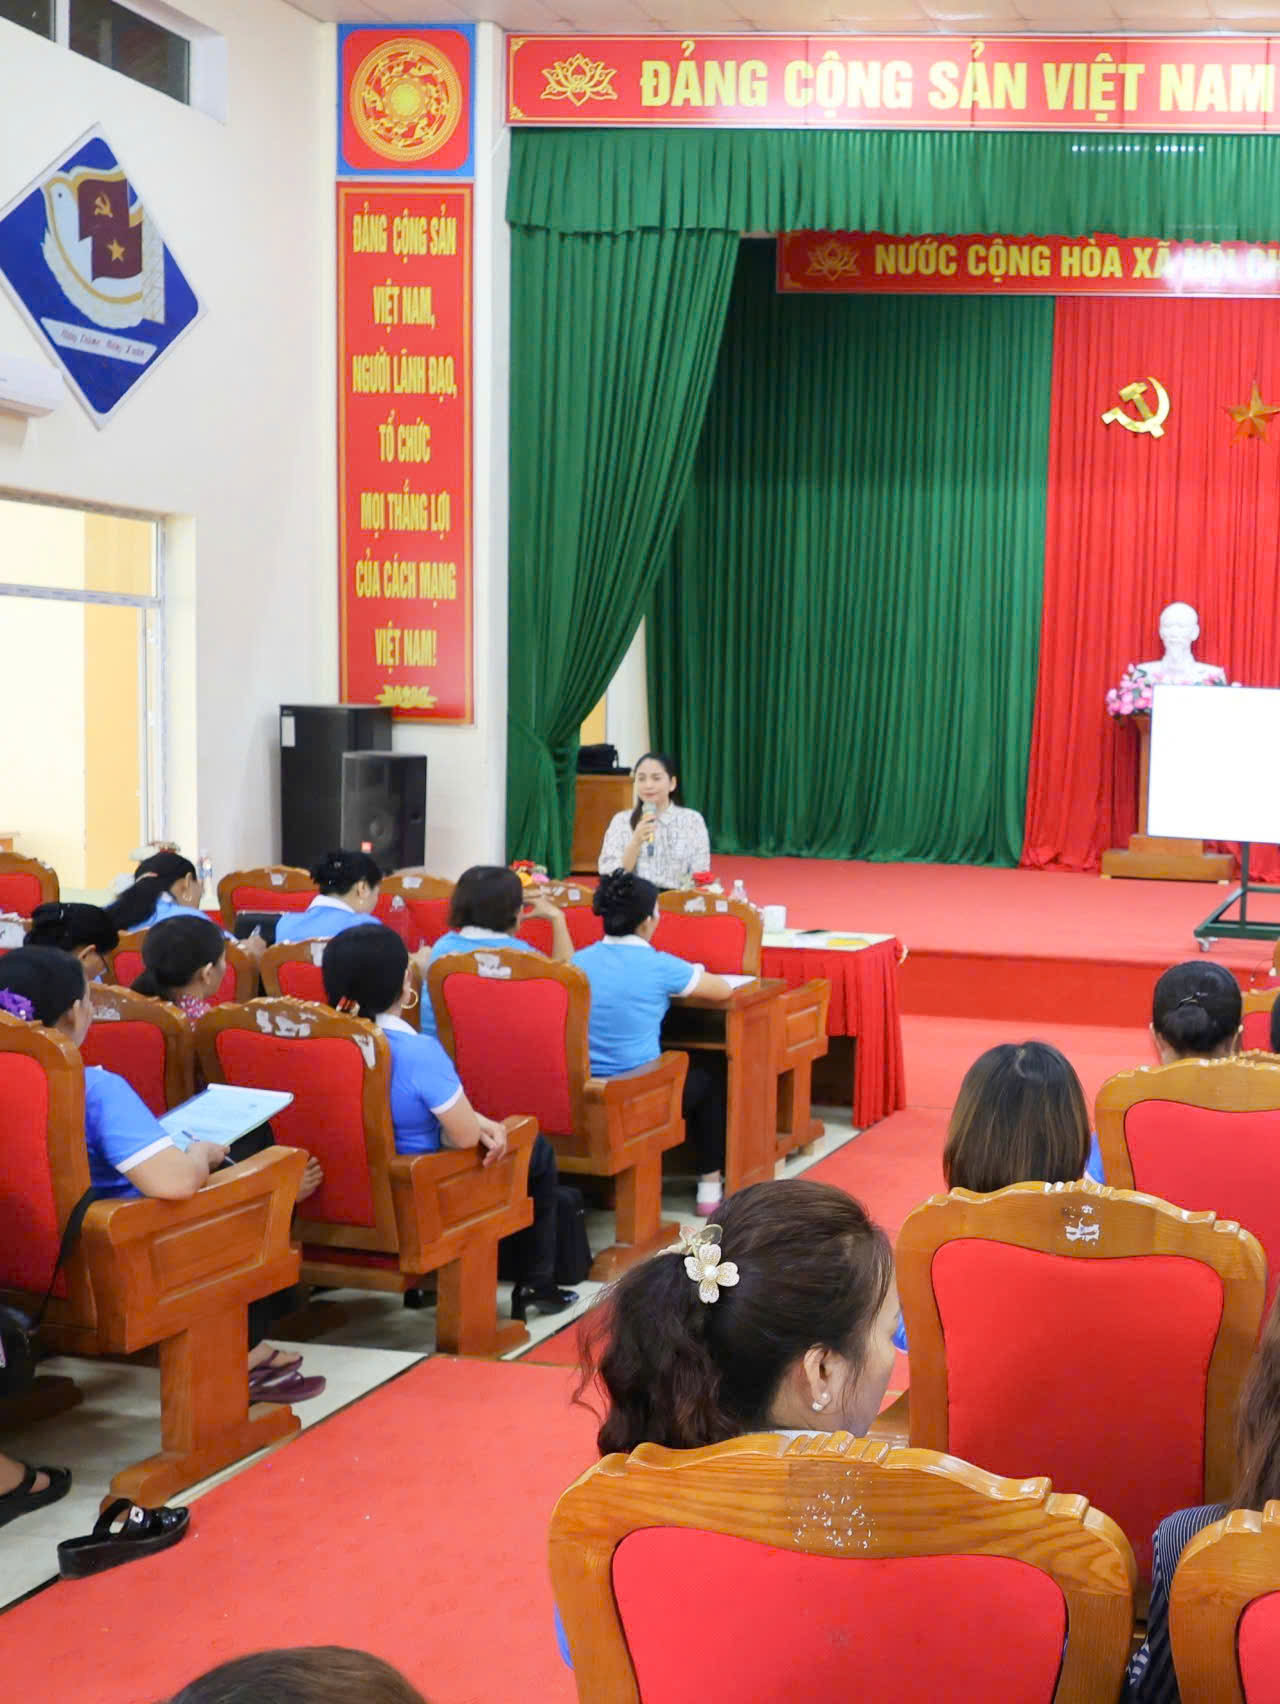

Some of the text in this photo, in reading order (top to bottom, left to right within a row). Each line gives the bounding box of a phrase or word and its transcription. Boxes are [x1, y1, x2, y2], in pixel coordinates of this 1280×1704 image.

[640, 40, 768, 107] ĐẢNG
[784, 50, 913, 118] CỘNG
[928, 40, 1027, 110] SẢN
[1042, 53, 1145, 121] VIỆT
[1160, 64, 1275, 112] NAM
[393, 207, 428, 264] CỘNG
[430, 202, 457, 255] SẢN
[874, 237, 958, 276] NƯỚC
[967, 238, 1051, 283] CỘNG
[1060, 238, 1123, 278] HÒA
[1132, 241, 1174, 279] XÃ
[372, 278, 400, 334] VIỆT
[398, 416, 431, 463] CHỨC
[361, 479, 450, 541] MỌI THẮNG LỢI
[355, 547, 457, 608] CỦA CÁCH MẠNG
[375, 620, 401, 674] VIỆT
